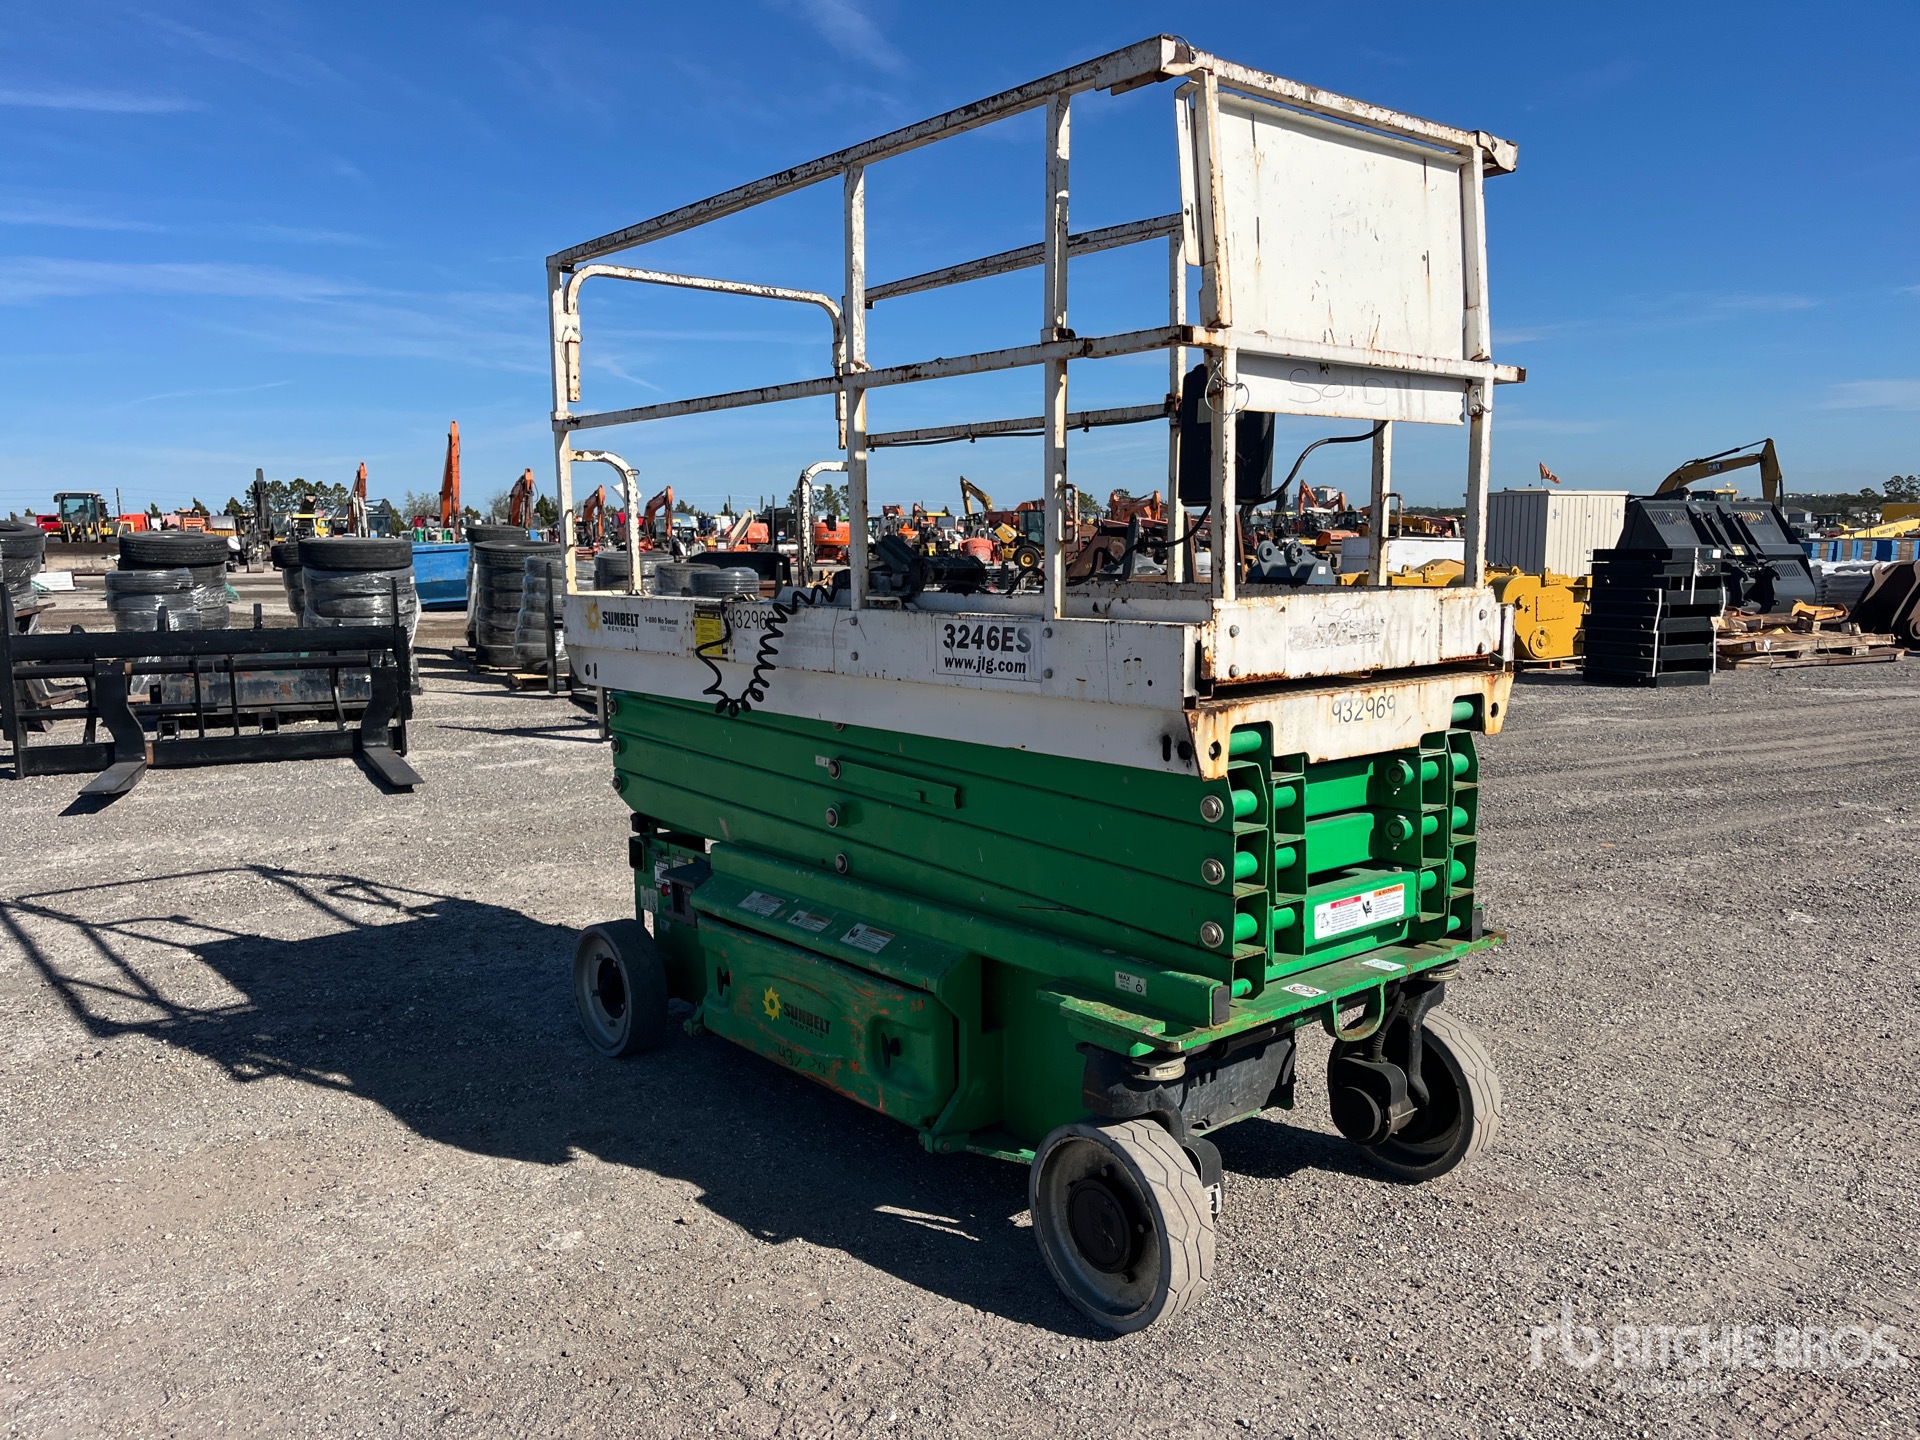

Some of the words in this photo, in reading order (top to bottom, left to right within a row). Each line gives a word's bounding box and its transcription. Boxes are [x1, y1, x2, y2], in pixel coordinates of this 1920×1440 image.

[1707, 463, 1721, 472] CAT
[602, 610, 640, 628] SUNBELT
[658, 616, 665, 625] No
[665, 617, 679, 626] Sweat
[607, 626, 635, 634] RENTALS
[943, 623, 1032, 653] 3246ES
[944, 655, 1027, 674] www.jlg.com
[364, 674, 372, 683] 2
[1331, 694, 1396, 725] 932969
[1118, 972, 1131, 983] MAX
[783, 1002, 831, 1035] SUNBELT
[789, 1021, 824, 1039] RENTALS
